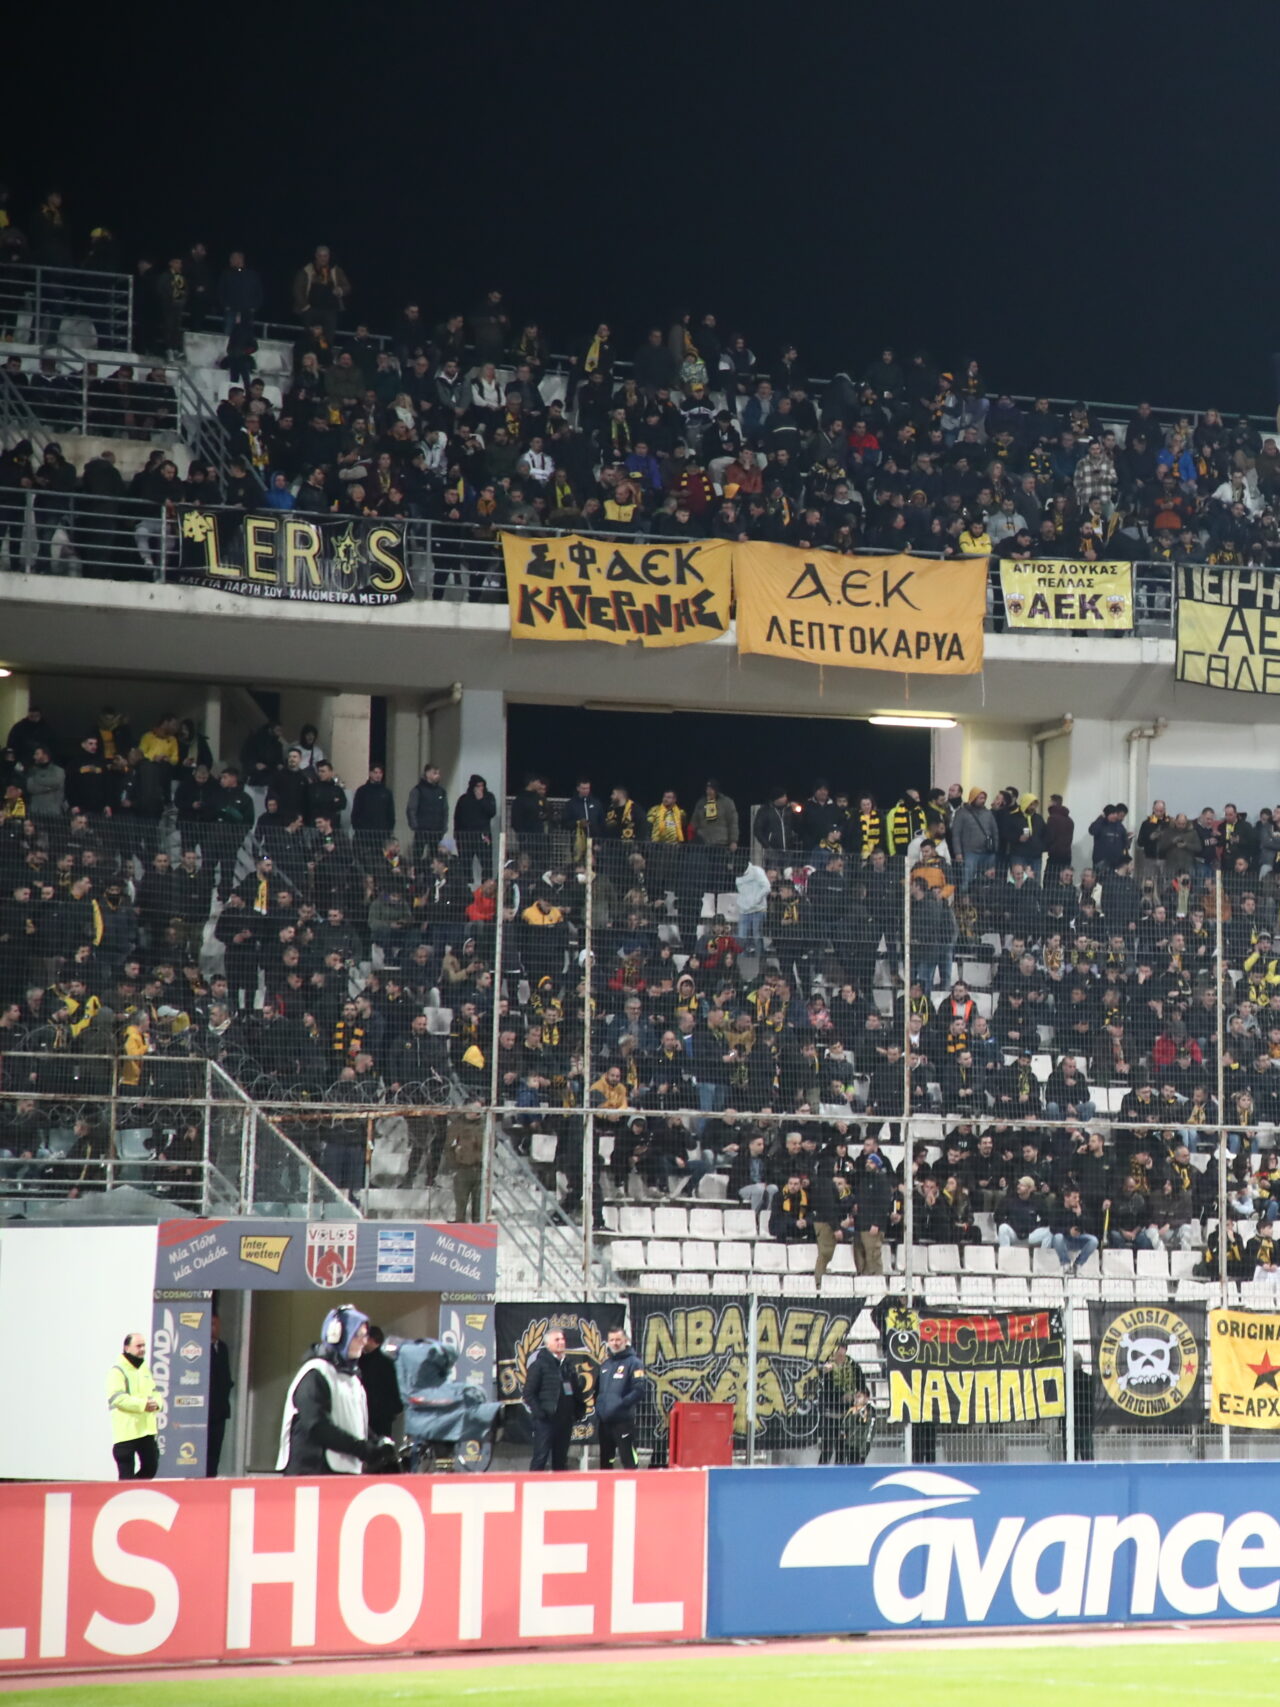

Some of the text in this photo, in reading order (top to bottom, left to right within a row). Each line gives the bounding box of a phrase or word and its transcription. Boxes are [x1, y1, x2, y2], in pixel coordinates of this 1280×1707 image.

[1013, 563, 1118, 576] ΑΓΙΟΣ ΛΟΥΚΑΣ
[1037, 577, 1095, 589] ΠΕΛΛΑΣ
[264, 586, 283, 599] ΣΟΥ
[289, 589, 356, 604] ΧΙΛΙΟΜΕΤΡΑ
[1027, 592, 1105, 620] ΑΕΚ
[517, 583, 724, 636] ΚΑΤΕΡΙΝΗΣ
[766, 615, 965, 662] ΛΕΠΤΟΚΑΡΥΑ
[242, 1237, 268, 1250] inter
[244, 1249, 281, 1259] wetten
[1102, 1310, 1197, 1356] ANO LIOSIA CLUB
[1117, 1387, 1184, 1415] ORIGINAL 21
[226, 1479, 685, 1651] HOTEL
